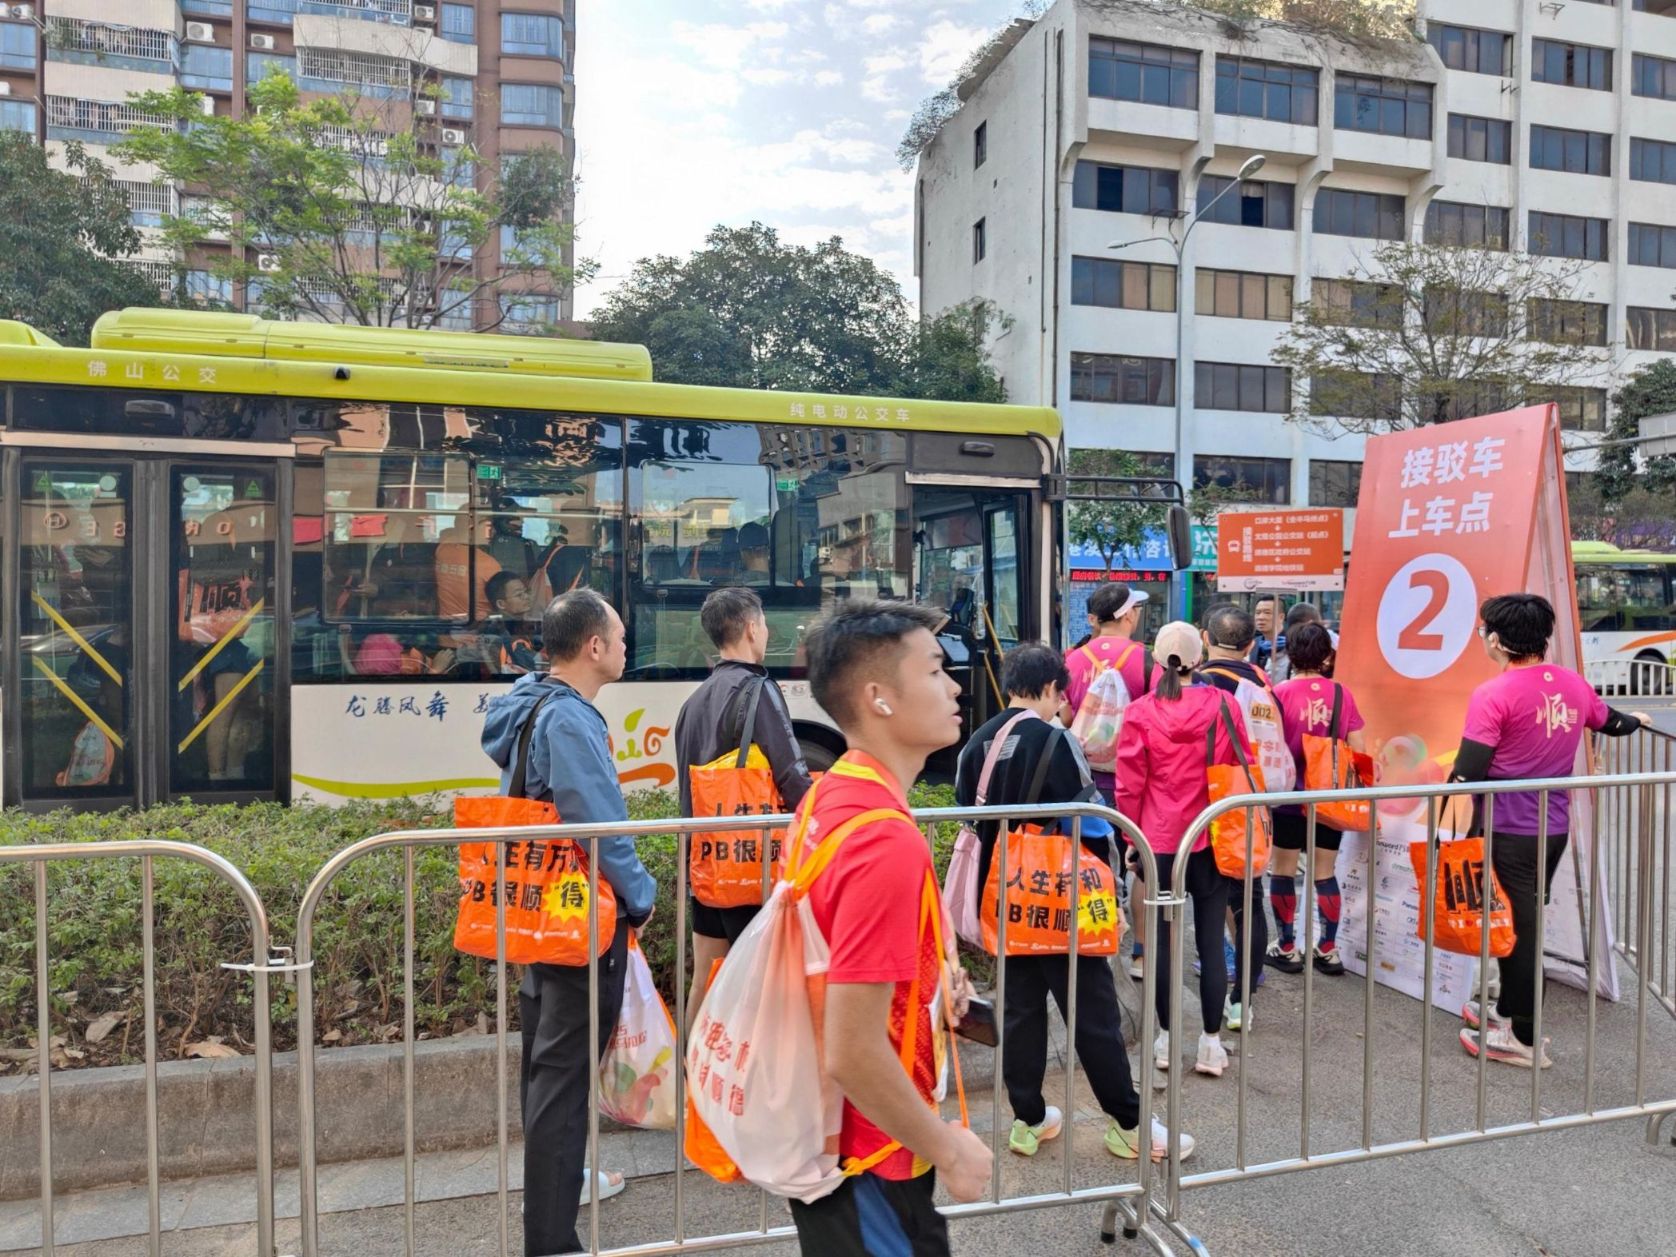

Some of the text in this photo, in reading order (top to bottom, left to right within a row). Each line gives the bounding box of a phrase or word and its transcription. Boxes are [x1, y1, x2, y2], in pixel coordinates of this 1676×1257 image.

[88, 360, 217, 384] 佛山公交
[790, 402, 910, 422] 纯电动公交车
[1400, 436, 1506, 489] 接驳车
[1387, 491, 1495, 539] 上车点
[1397, 569, 1450, 651] 2
[1535, 690, 1572, 739] 顺
